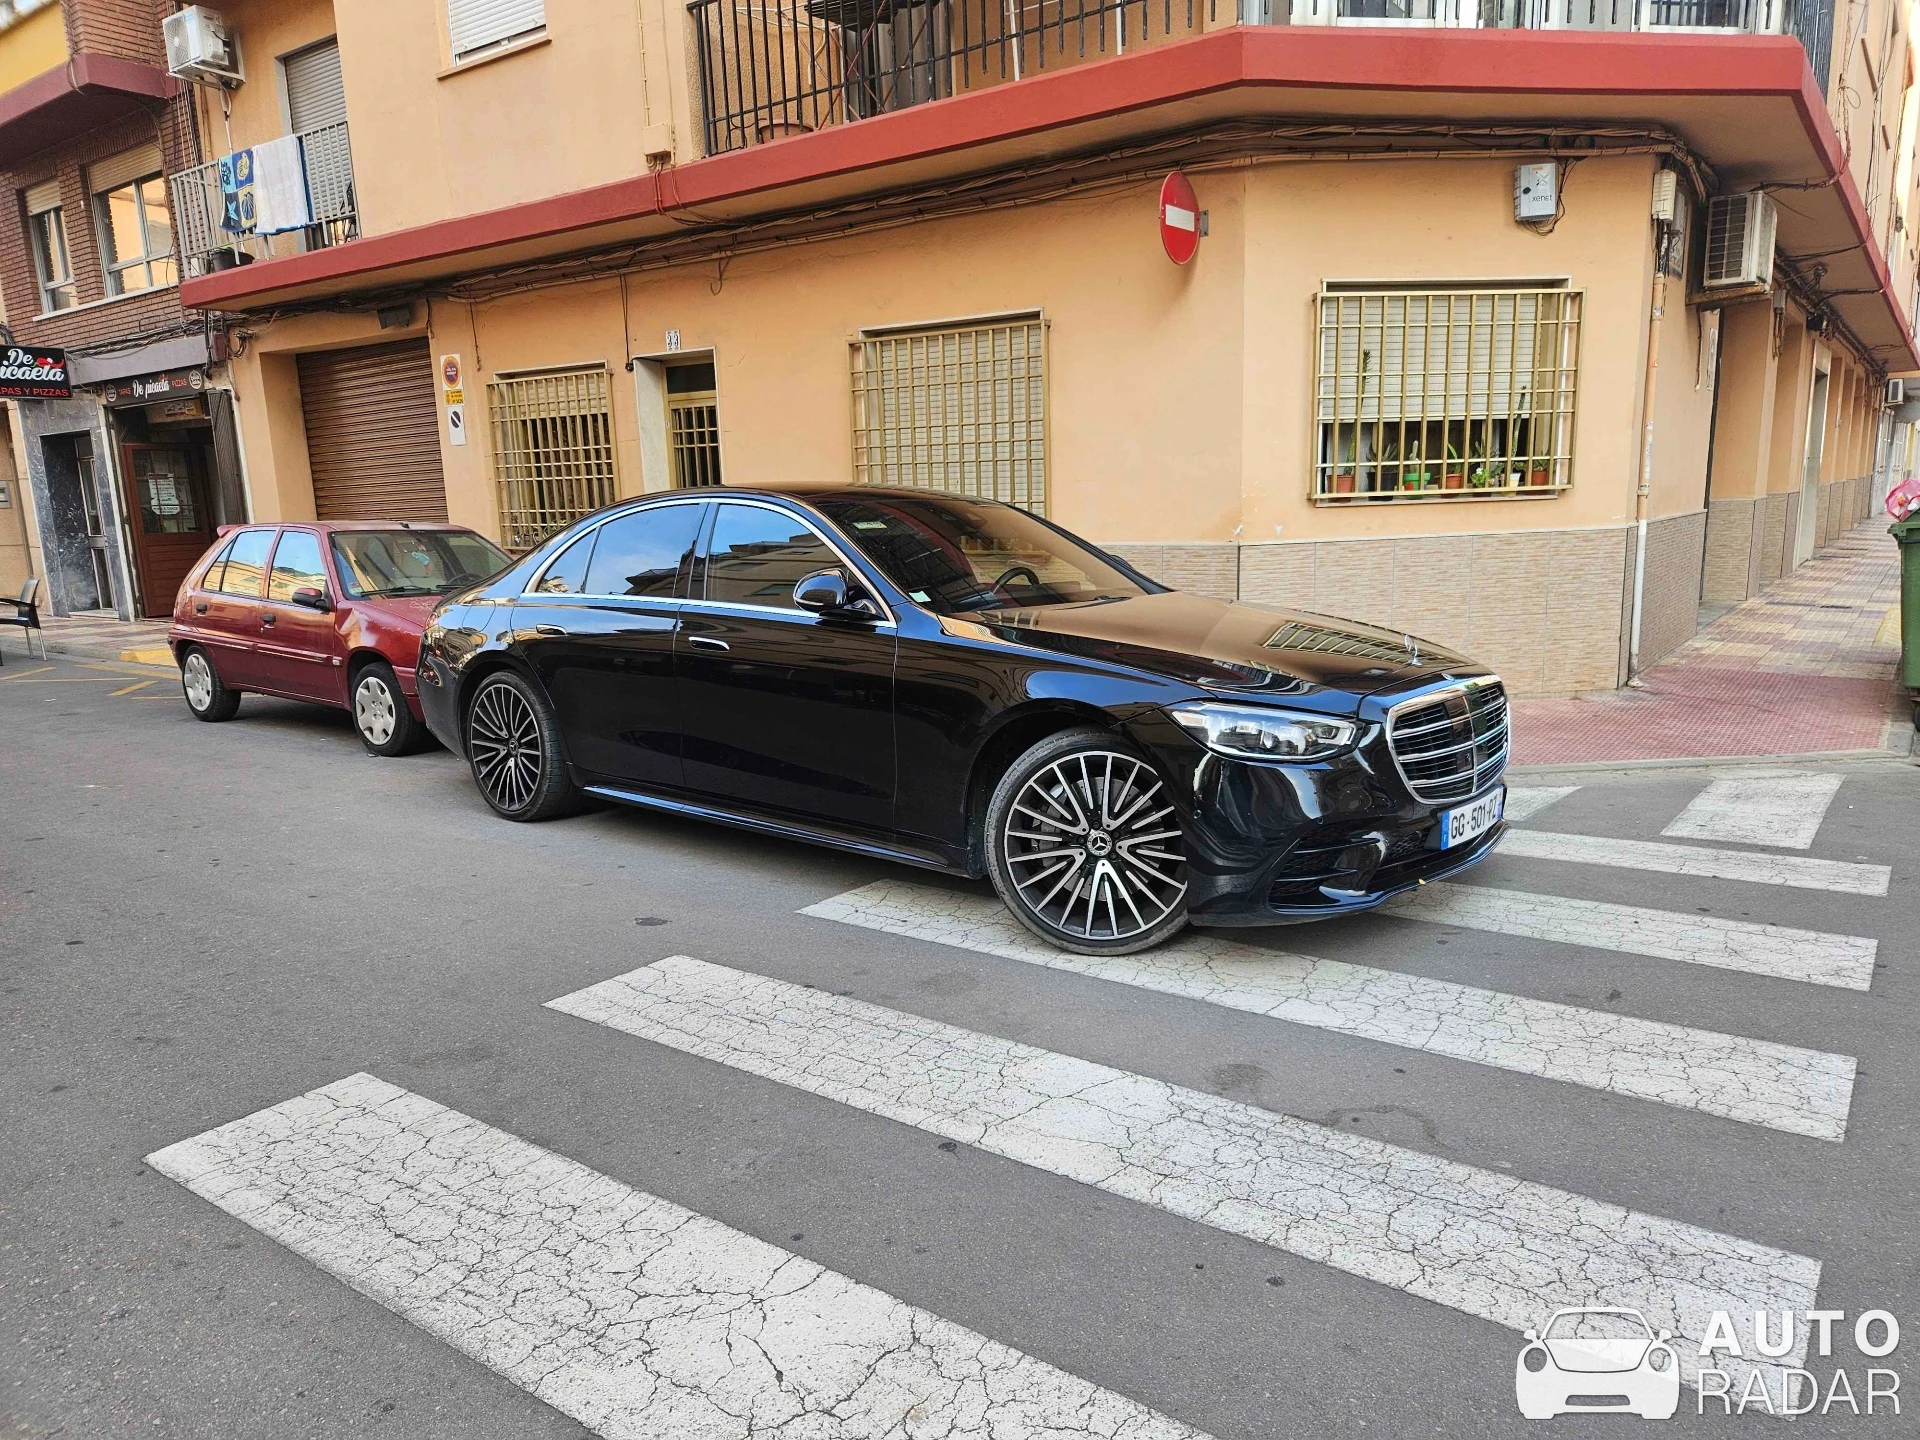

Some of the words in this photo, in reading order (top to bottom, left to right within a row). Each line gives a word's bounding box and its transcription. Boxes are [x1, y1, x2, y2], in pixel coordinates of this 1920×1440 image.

[8, 349, 33, 366] De
[0, 387, 22, 396] PAS
[24, 387, 30, 395] Y
[33, 388, 69, 397] PIZZAS
[133, 380, 144, 397] De
